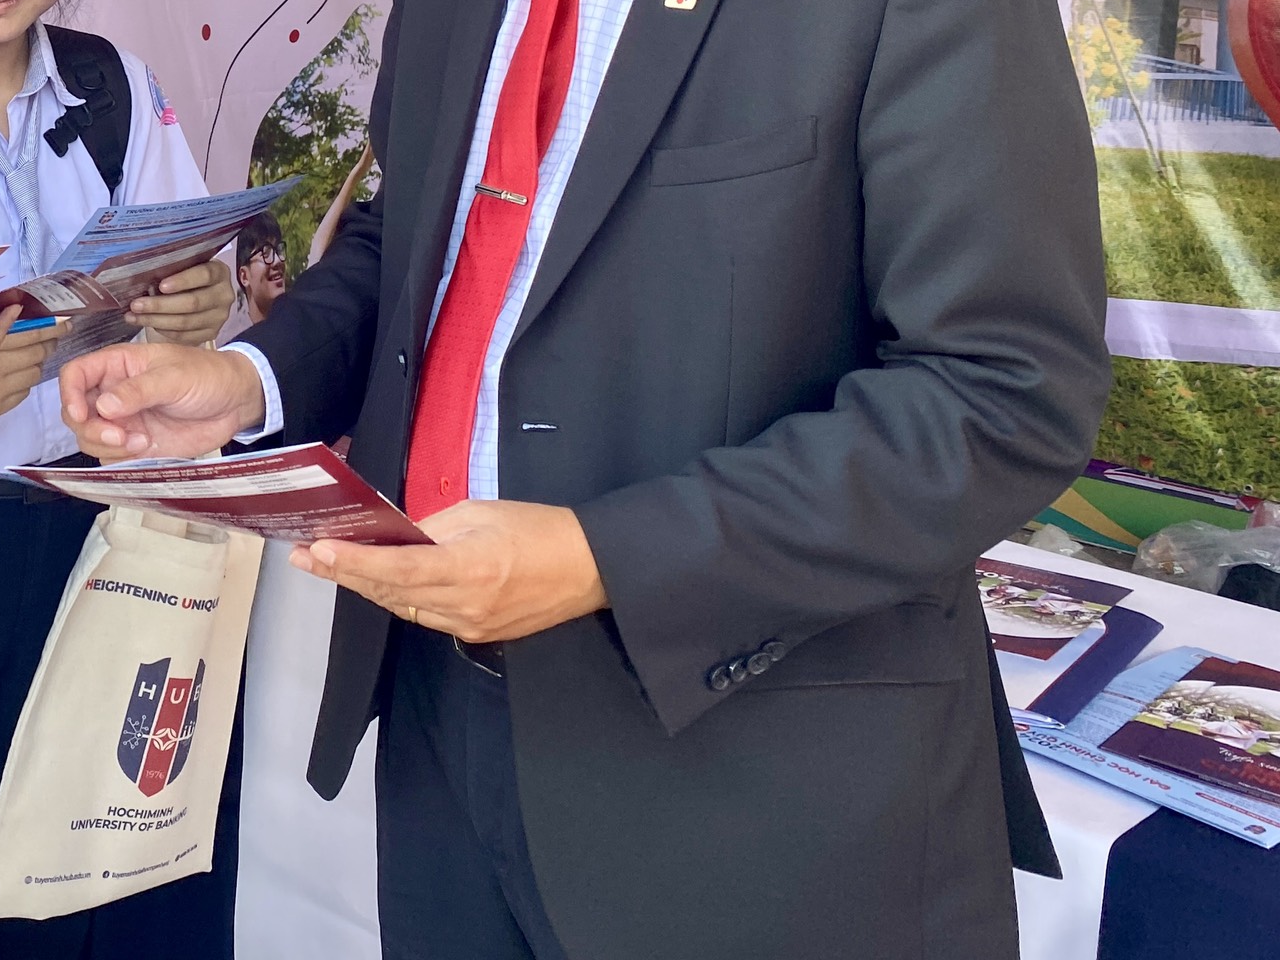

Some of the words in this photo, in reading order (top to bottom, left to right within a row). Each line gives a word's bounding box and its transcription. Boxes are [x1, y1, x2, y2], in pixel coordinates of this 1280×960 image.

[85, 579, 178, 606] HEIGHTENING
[107, 806, 173, 819] HOCHIMINH
[70, 818, 137, 831] UNIVERSITY
[138, 821, 154, 831] OF
